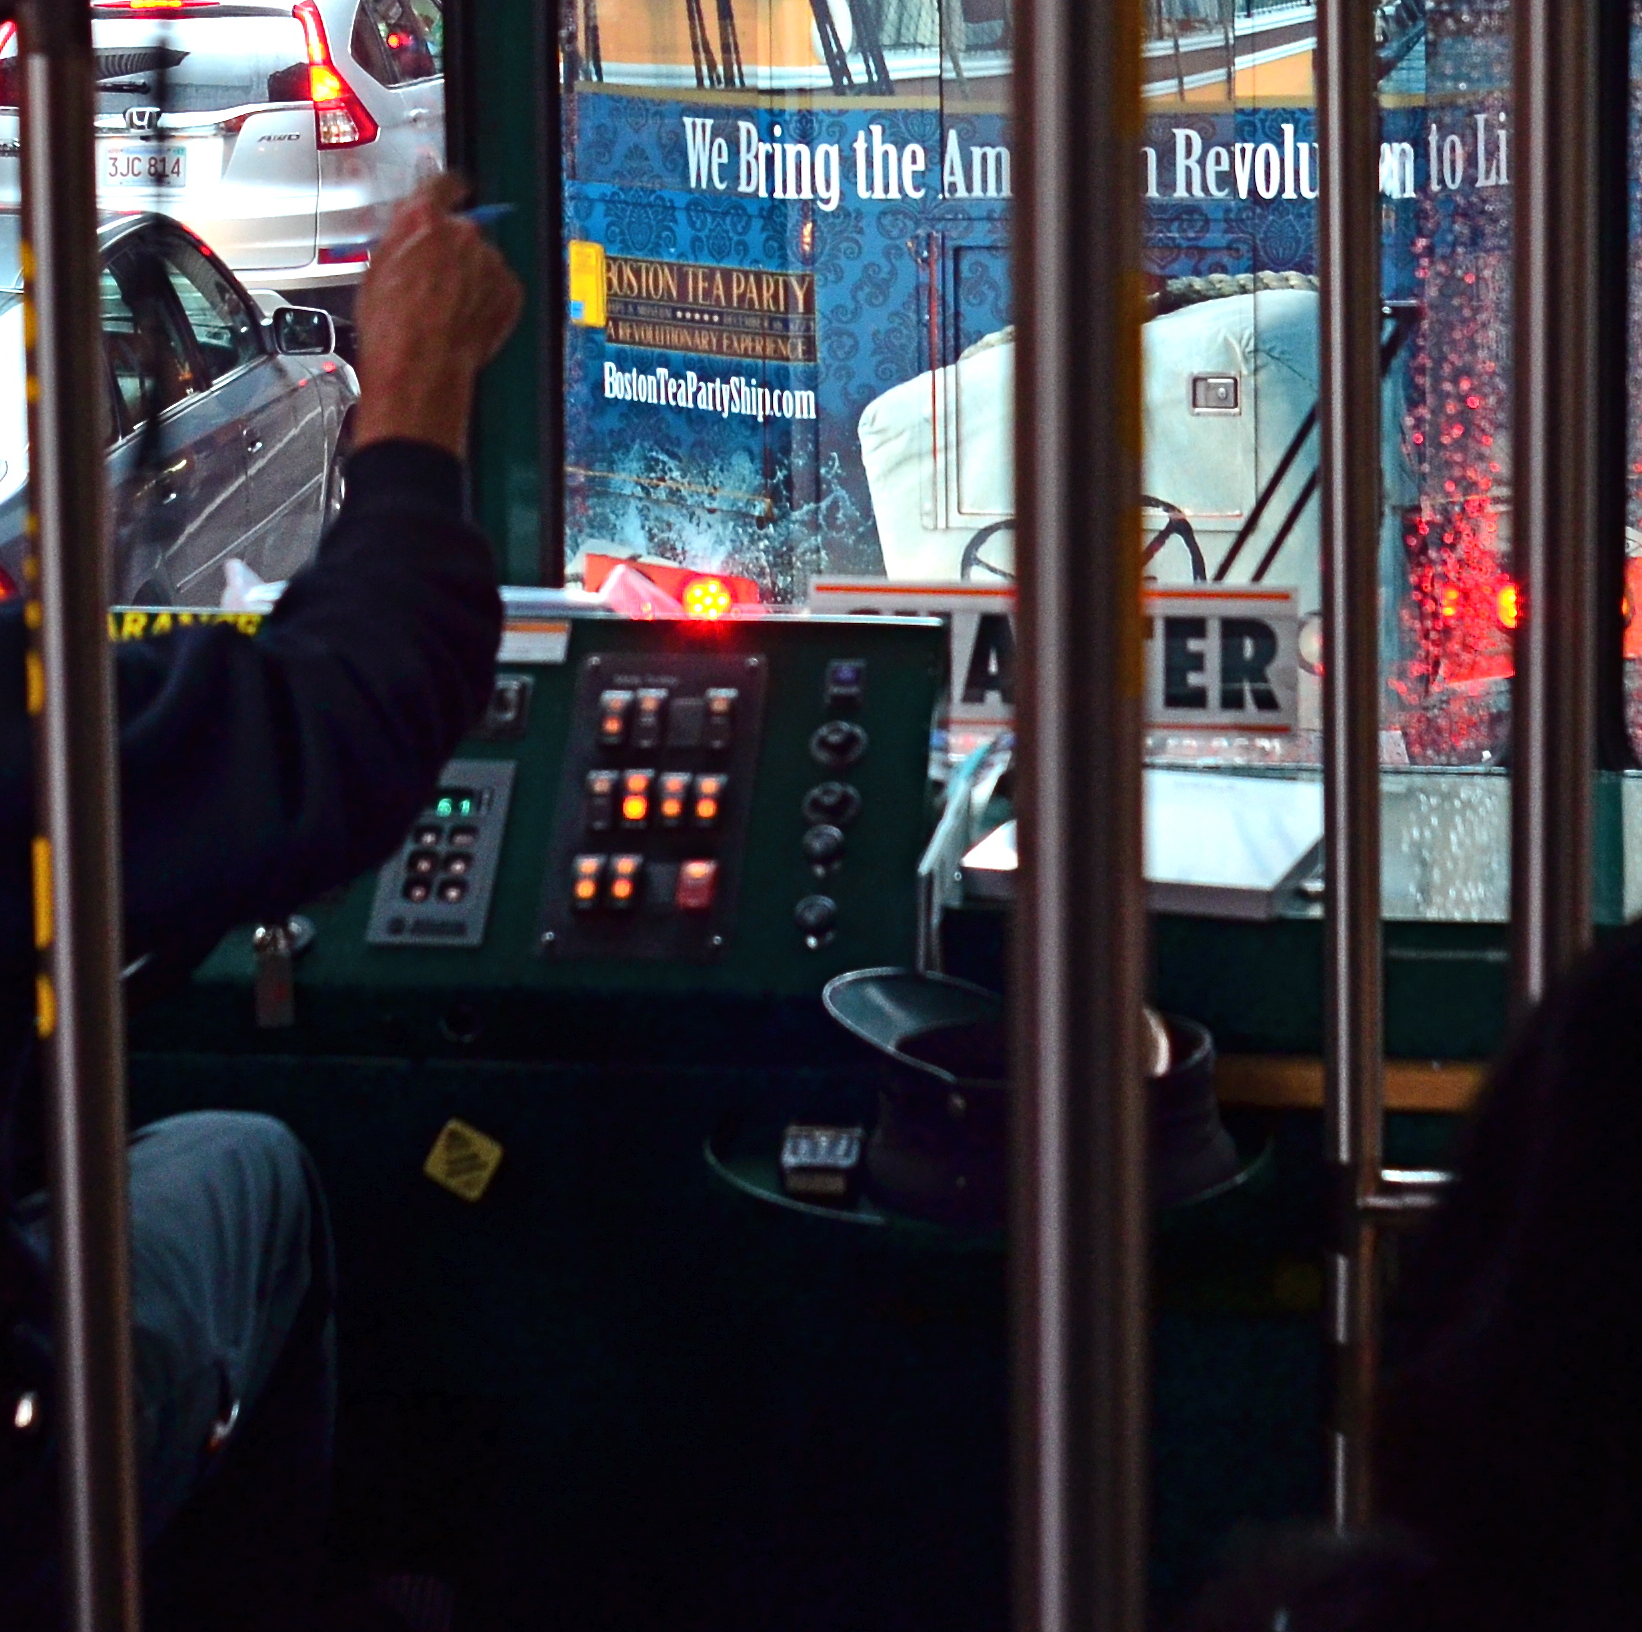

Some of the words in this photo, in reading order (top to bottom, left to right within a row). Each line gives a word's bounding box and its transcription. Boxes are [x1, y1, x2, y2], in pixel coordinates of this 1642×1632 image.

[256, 132, 301, 143] AWD
[108, 155, 142, 178] 3JC
[147, 155, 183, 177] 814
[682, 116, 729, 191] We
[737, 120, 841, 212] Bring
[853, 124, 926, 200] the
[1428, 122, 1464, 192] to
[1474, 111, 1510, 188] Li
[606, 259, 678, 301] BOSTON
[683, 267, 726, 307] TEA
[732, 271, 812, 314] PARTY
[607, 320, 617, 340] A
[618, 321, 719, 351] REVOLUTIONARY
[722, 332, 807, 359] EXPERIENCE
[603, 361, 818, 423] BostonTeaPartyShip.com
